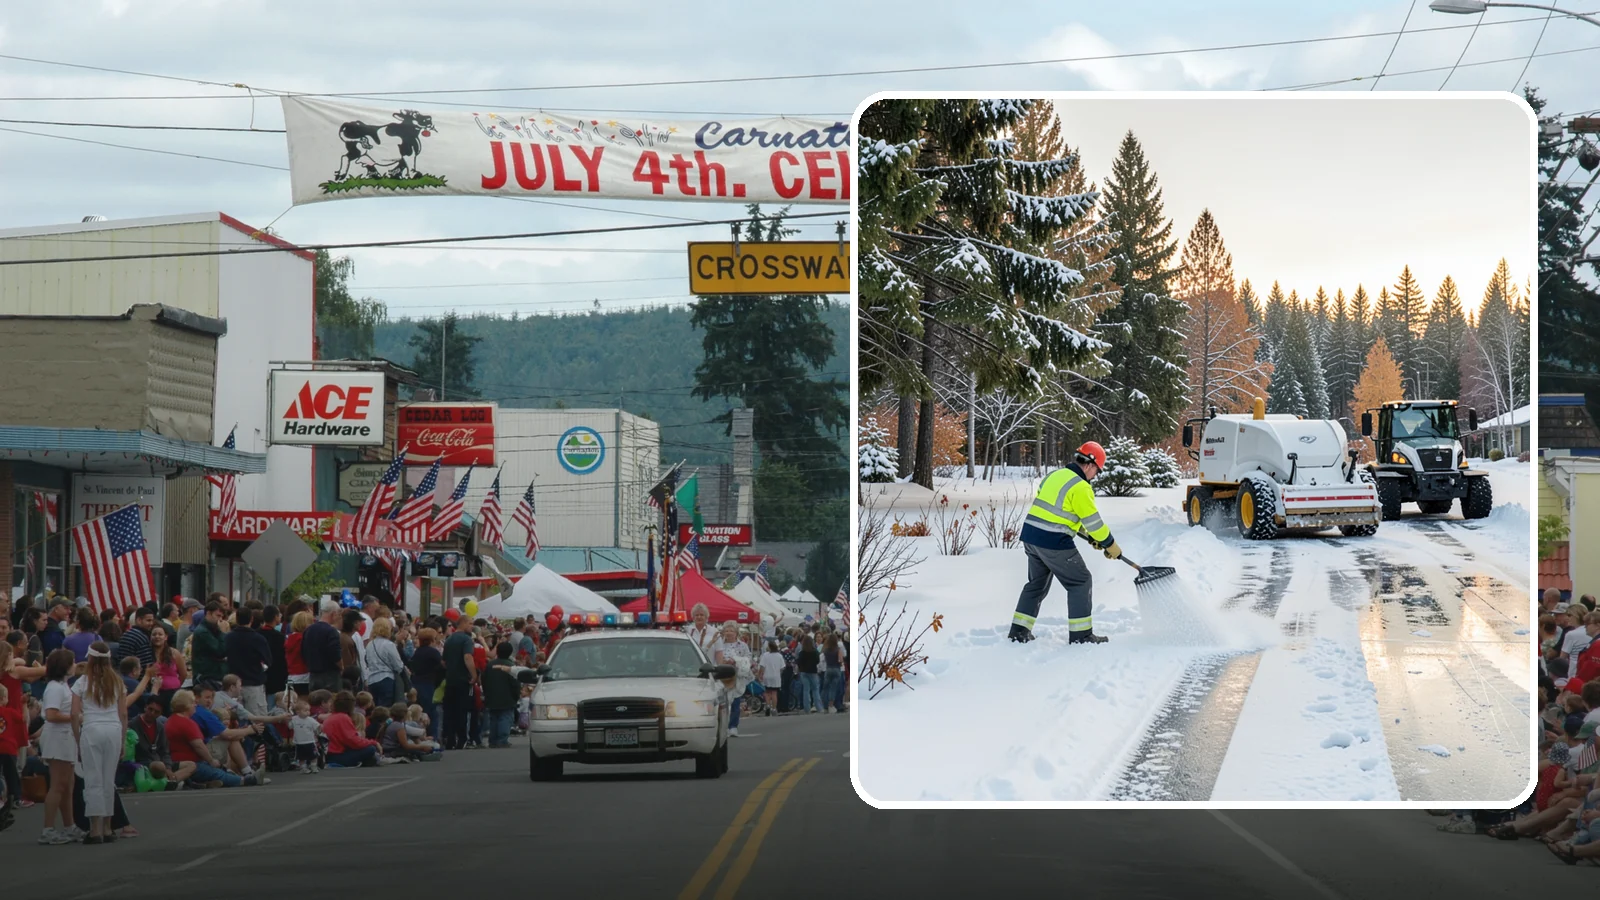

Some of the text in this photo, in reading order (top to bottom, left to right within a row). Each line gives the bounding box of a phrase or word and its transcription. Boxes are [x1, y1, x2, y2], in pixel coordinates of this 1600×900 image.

[481, 141, 605, 192] JULY
[632, 149, 747, 198] 4th.
[696, 254, 850, 280] CROSSWA
[282, 380, 374, 420] ACE
[406, 408, 486, 422] CEDAR LOG
[283, 421, 371, 437] Hardware
[353, 467, 385, 480] Simpl
[96, 485, 125, 495] Vincent
[126, 486, 136, 495] de
[137, 486, 155, 495] Paul
[687, 526, 741, 535] CRNATION
[699, 535, 730, 543] GLASS
